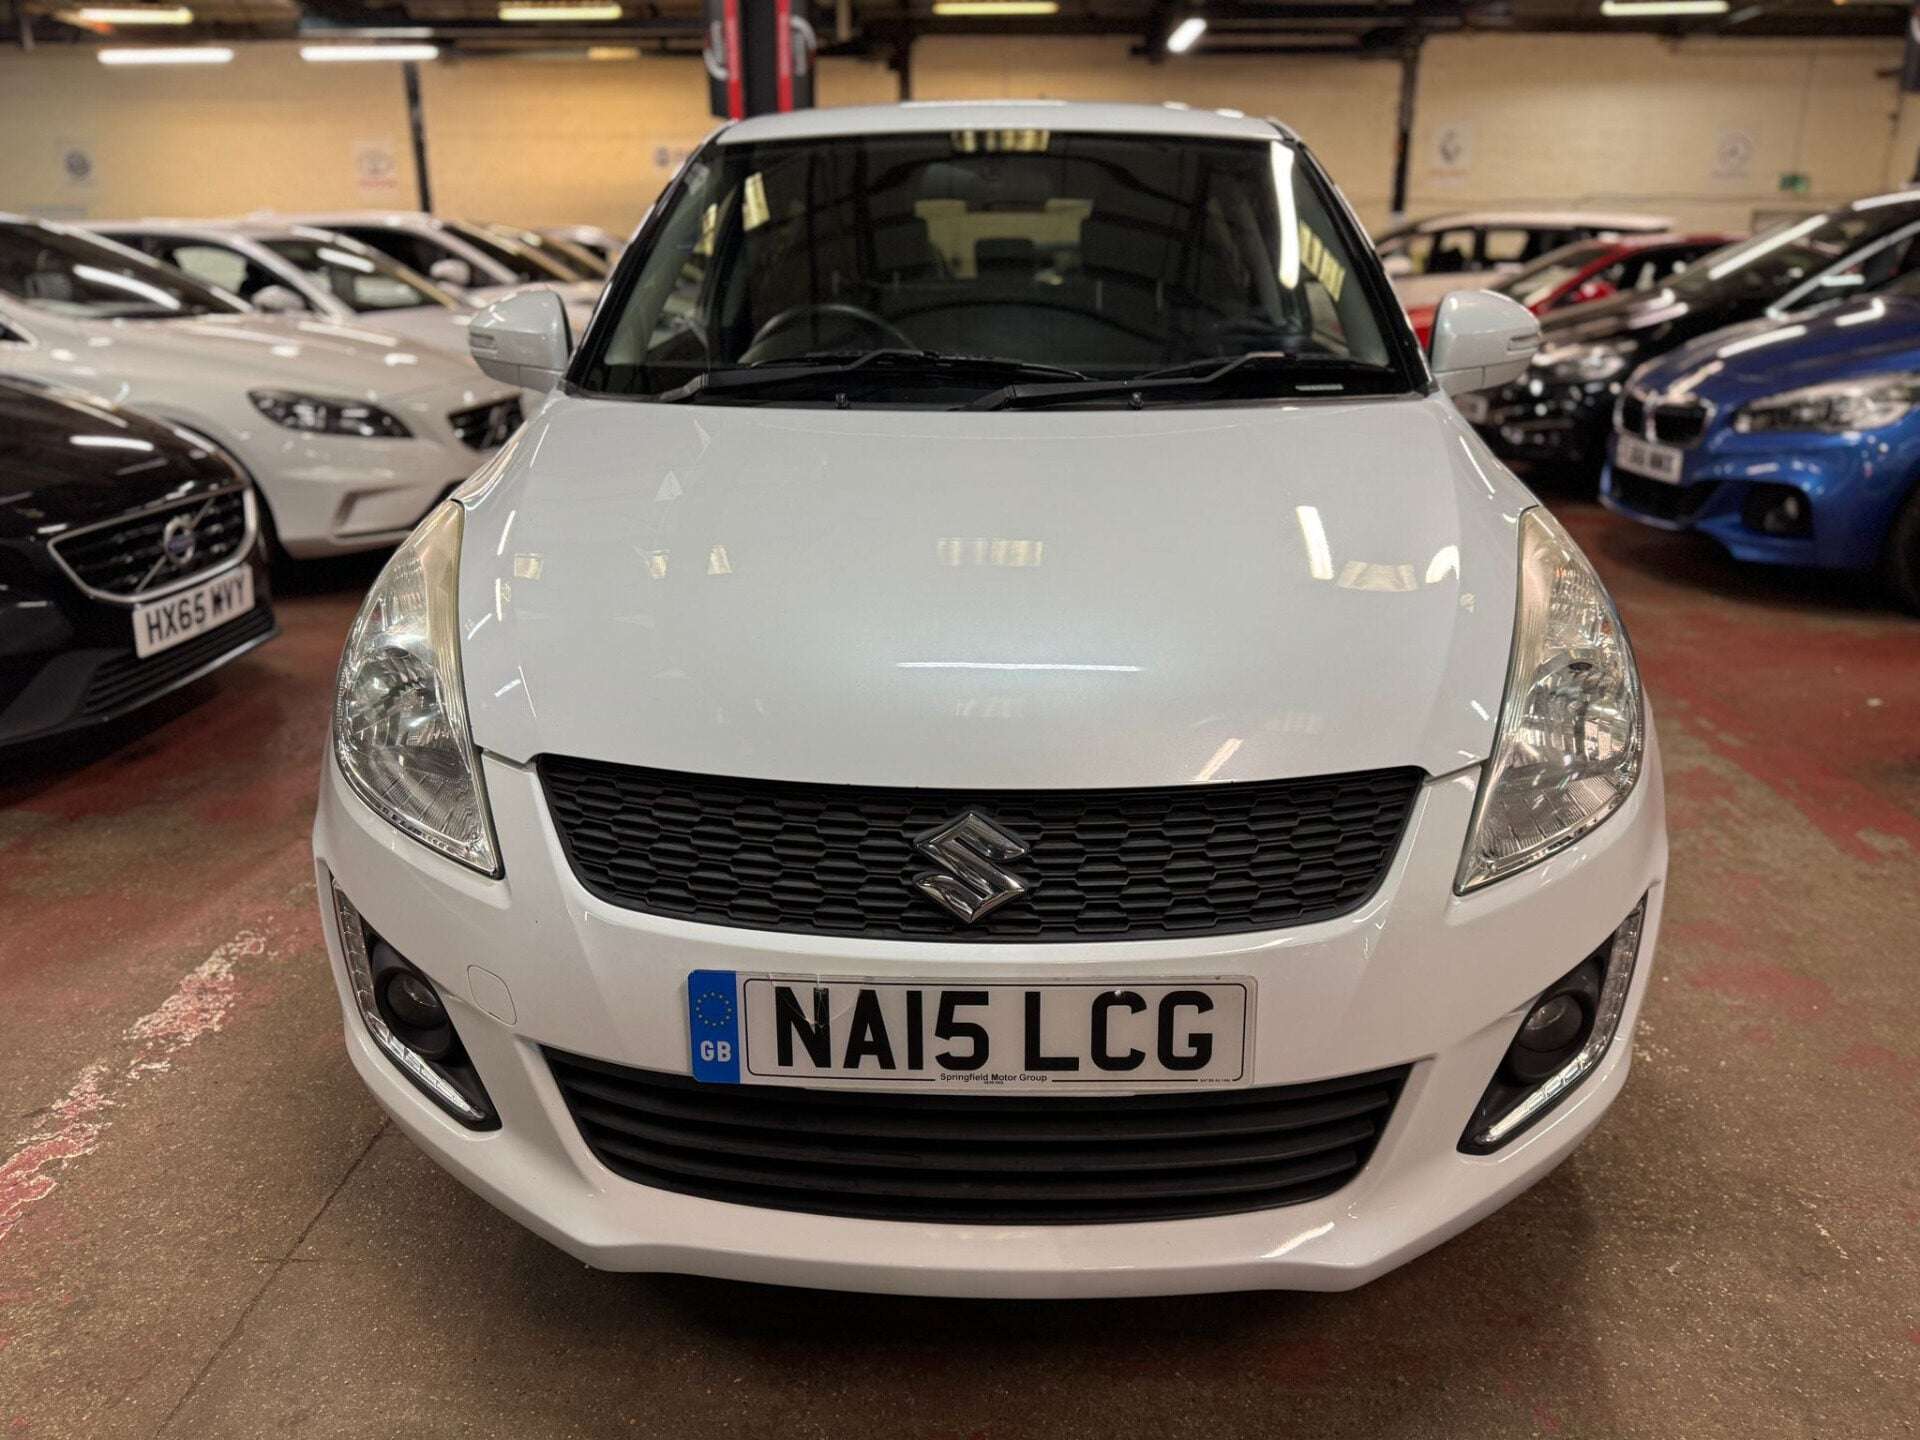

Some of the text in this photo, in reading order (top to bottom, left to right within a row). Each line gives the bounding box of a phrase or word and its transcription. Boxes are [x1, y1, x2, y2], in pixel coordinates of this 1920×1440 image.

[146, 592, 206, 644] HX65
[775, 986, 1214, 1071] NA15 LCG
[700, 1039, 732, 1063] GB
[940, 1072, 1047, 1083] Springfield Motor Group
